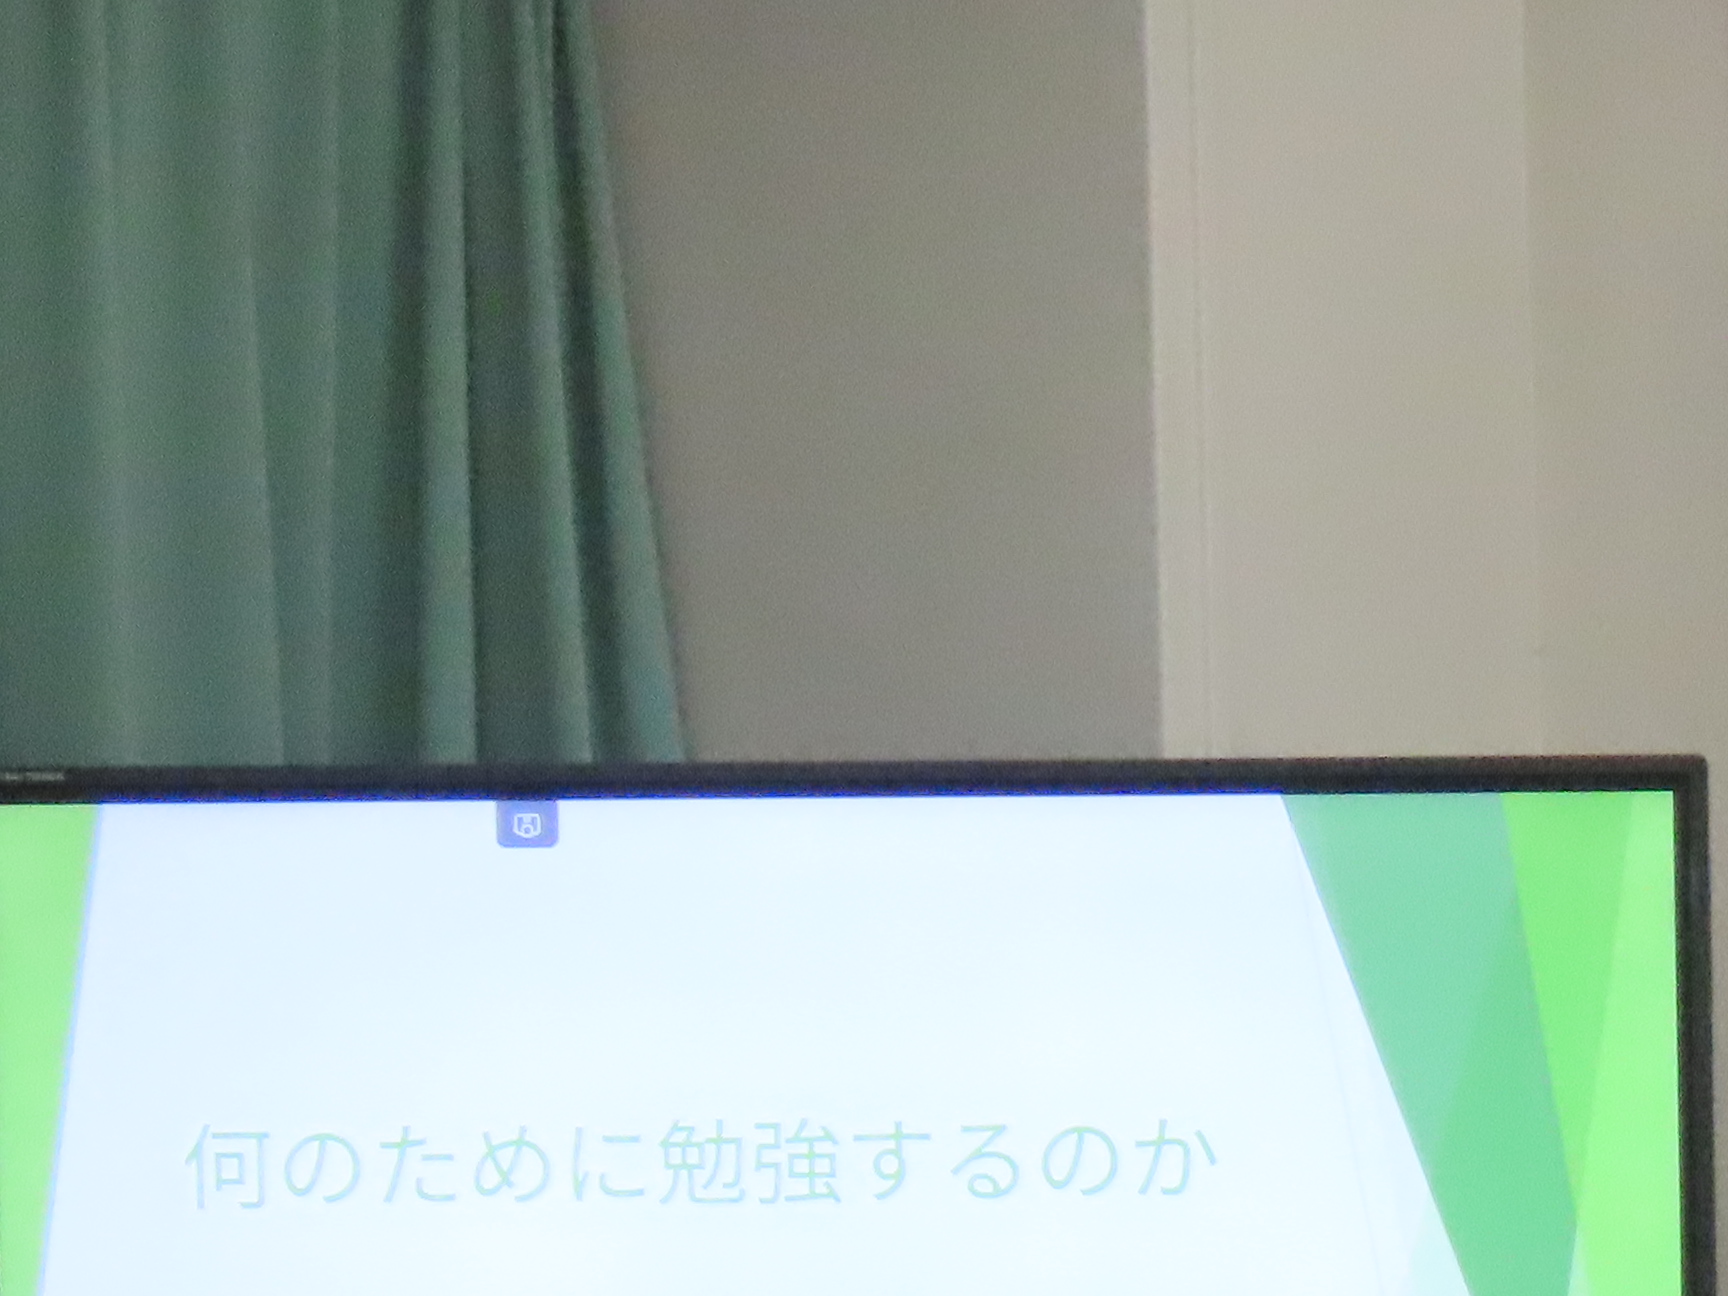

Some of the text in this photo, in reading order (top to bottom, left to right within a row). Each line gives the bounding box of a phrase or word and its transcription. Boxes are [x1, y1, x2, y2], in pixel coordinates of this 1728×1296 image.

[184, 1118, 1219, 1211] 何のために勉強するのか
